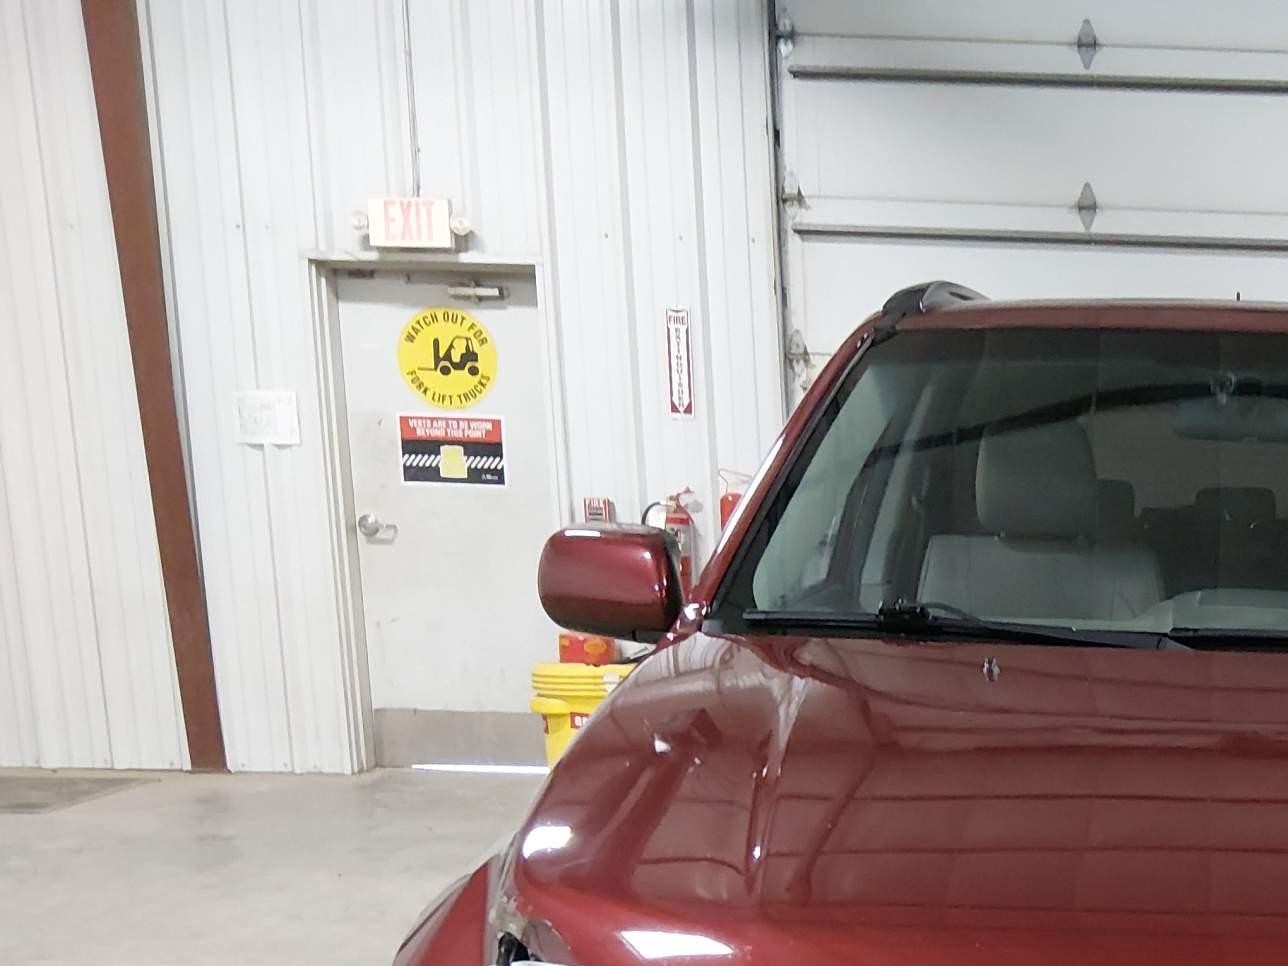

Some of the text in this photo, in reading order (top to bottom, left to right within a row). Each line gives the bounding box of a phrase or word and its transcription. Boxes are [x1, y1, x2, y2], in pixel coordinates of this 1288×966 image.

[383, 199, 434, 241] EXIT
[405, 311, 488, 347] WATCH OUT FOR
[668, 315, 686, 325] FIRE
[406, 369, 491, 406] FORK LIFT TRUCKS
